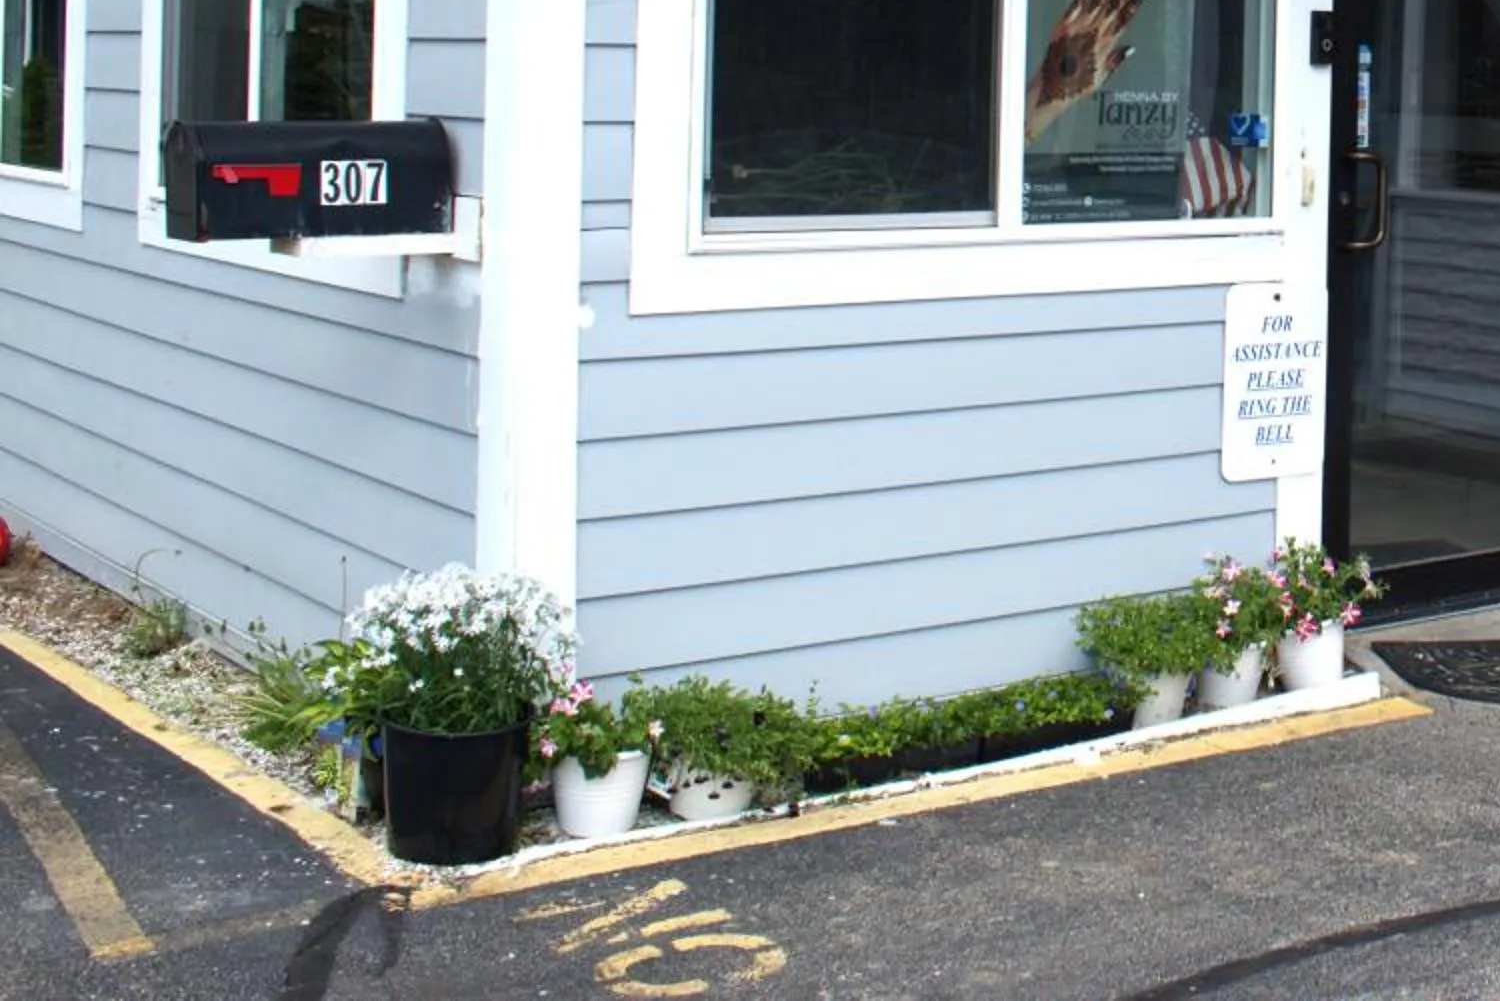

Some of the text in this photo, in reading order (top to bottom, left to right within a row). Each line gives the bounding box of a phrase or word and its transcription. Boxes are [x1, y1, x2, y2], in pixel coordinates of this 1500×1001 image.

[322, 162, 385, 203] 307
[1261, 315, 1293, 334] FOR
[1231, 340, 1323, 363] ASSISTANCE
[1247, 368, 1306, 389] PLEASE
[1238, 395, 1312, 418] RING THE
[1255, 423, 1294, 444] BELL
